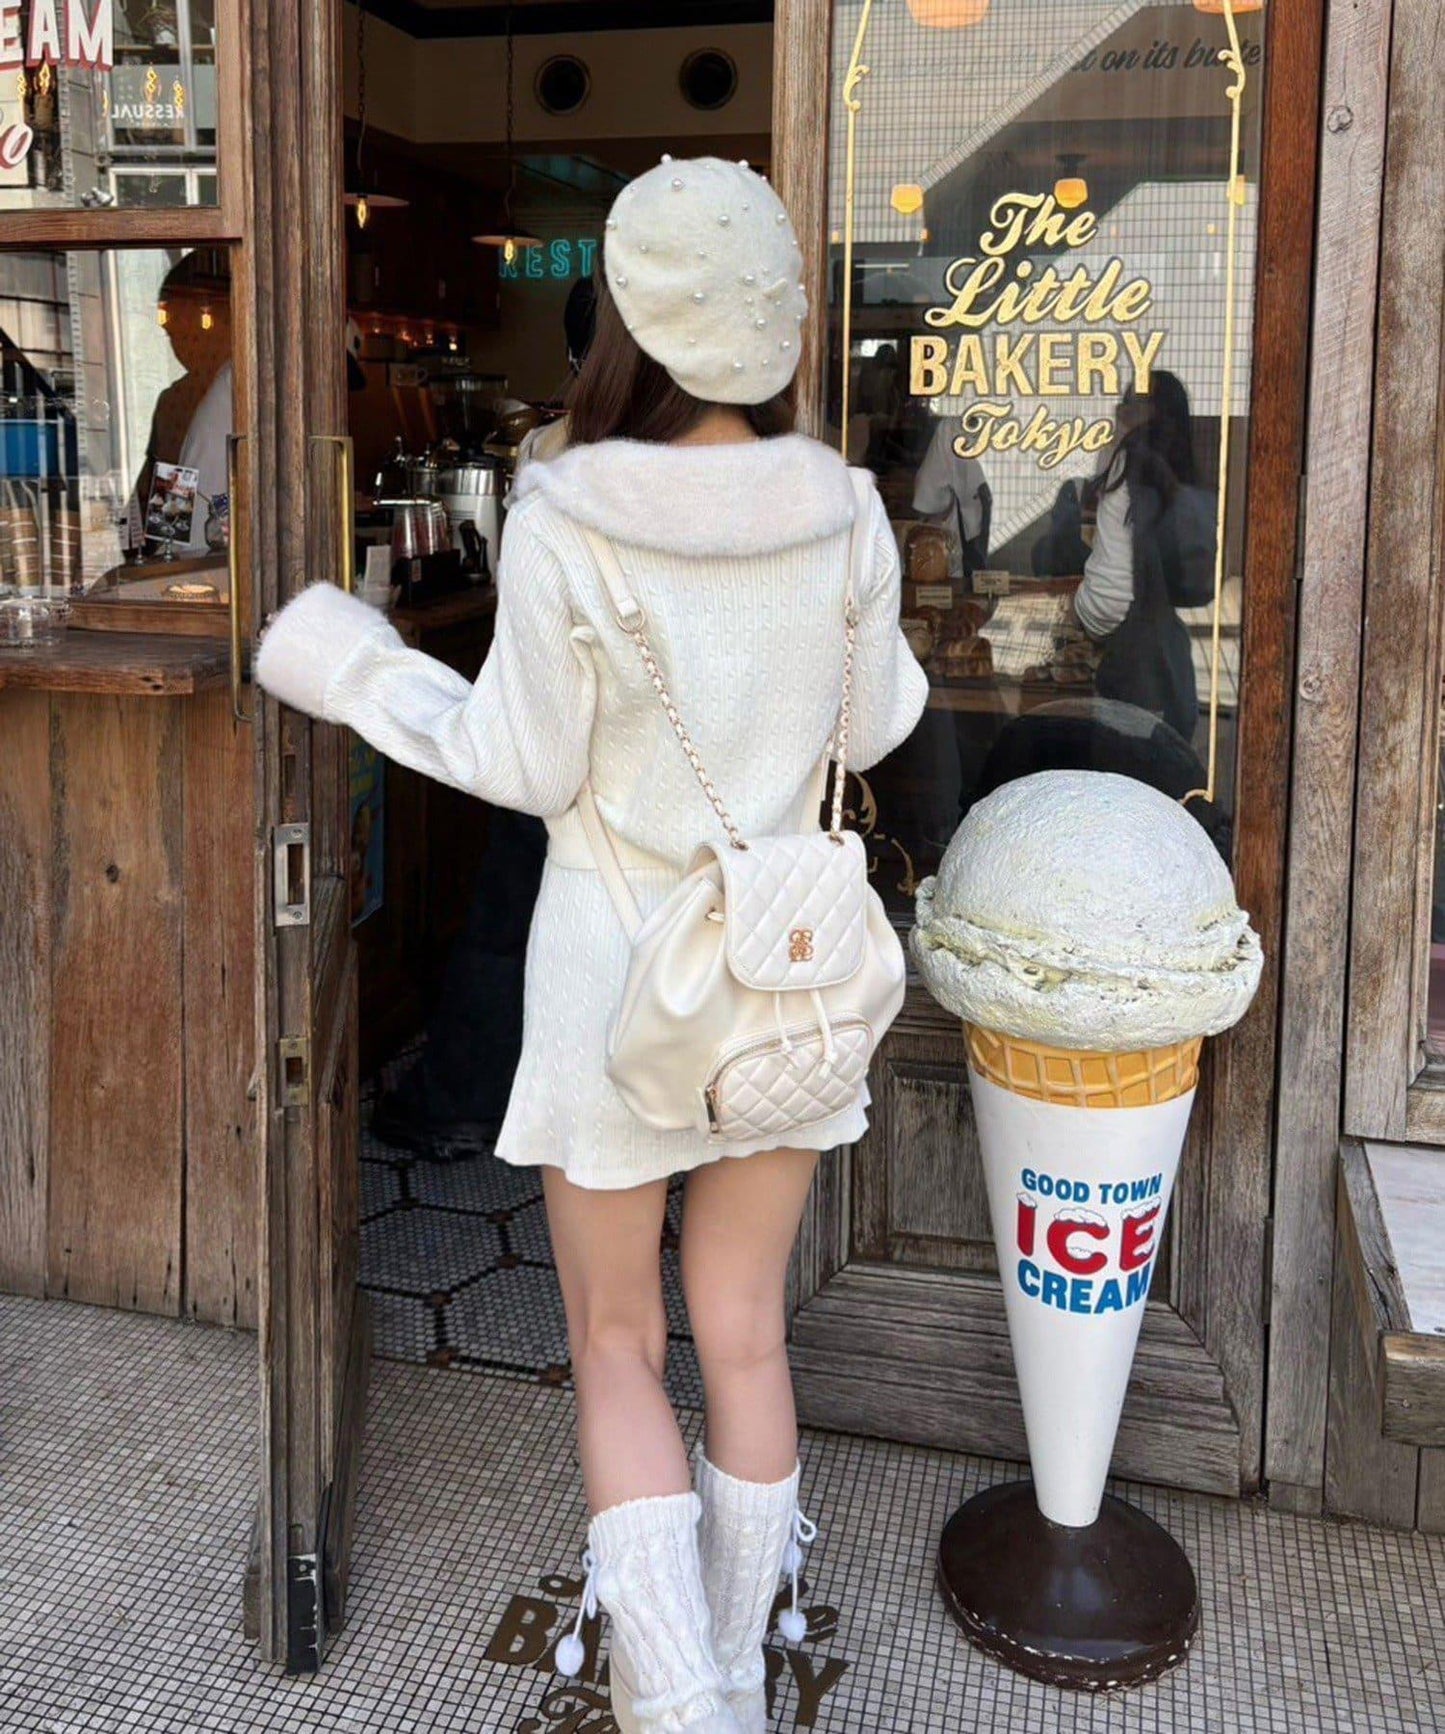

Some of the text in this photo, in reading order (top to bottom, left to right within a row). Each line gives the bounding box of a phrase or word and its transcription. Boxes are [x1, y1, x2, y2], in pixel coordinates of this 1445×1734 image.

[1101, 48, 1140, 72] on
[1143, 40, 1179, 70] its
[979, 191, 1098, 257] The
[924, 256, 1153, 329] Little
[908, 331, 1166, 397] BAKERY
[952, 401, 1114, 469] Tokyo
[1021, 1168, 1163, 1205] GOOD TOWN
[1016, 1191, 1162, 1276] ICE
[1018, 1258, 1150, 1316] CREAM
